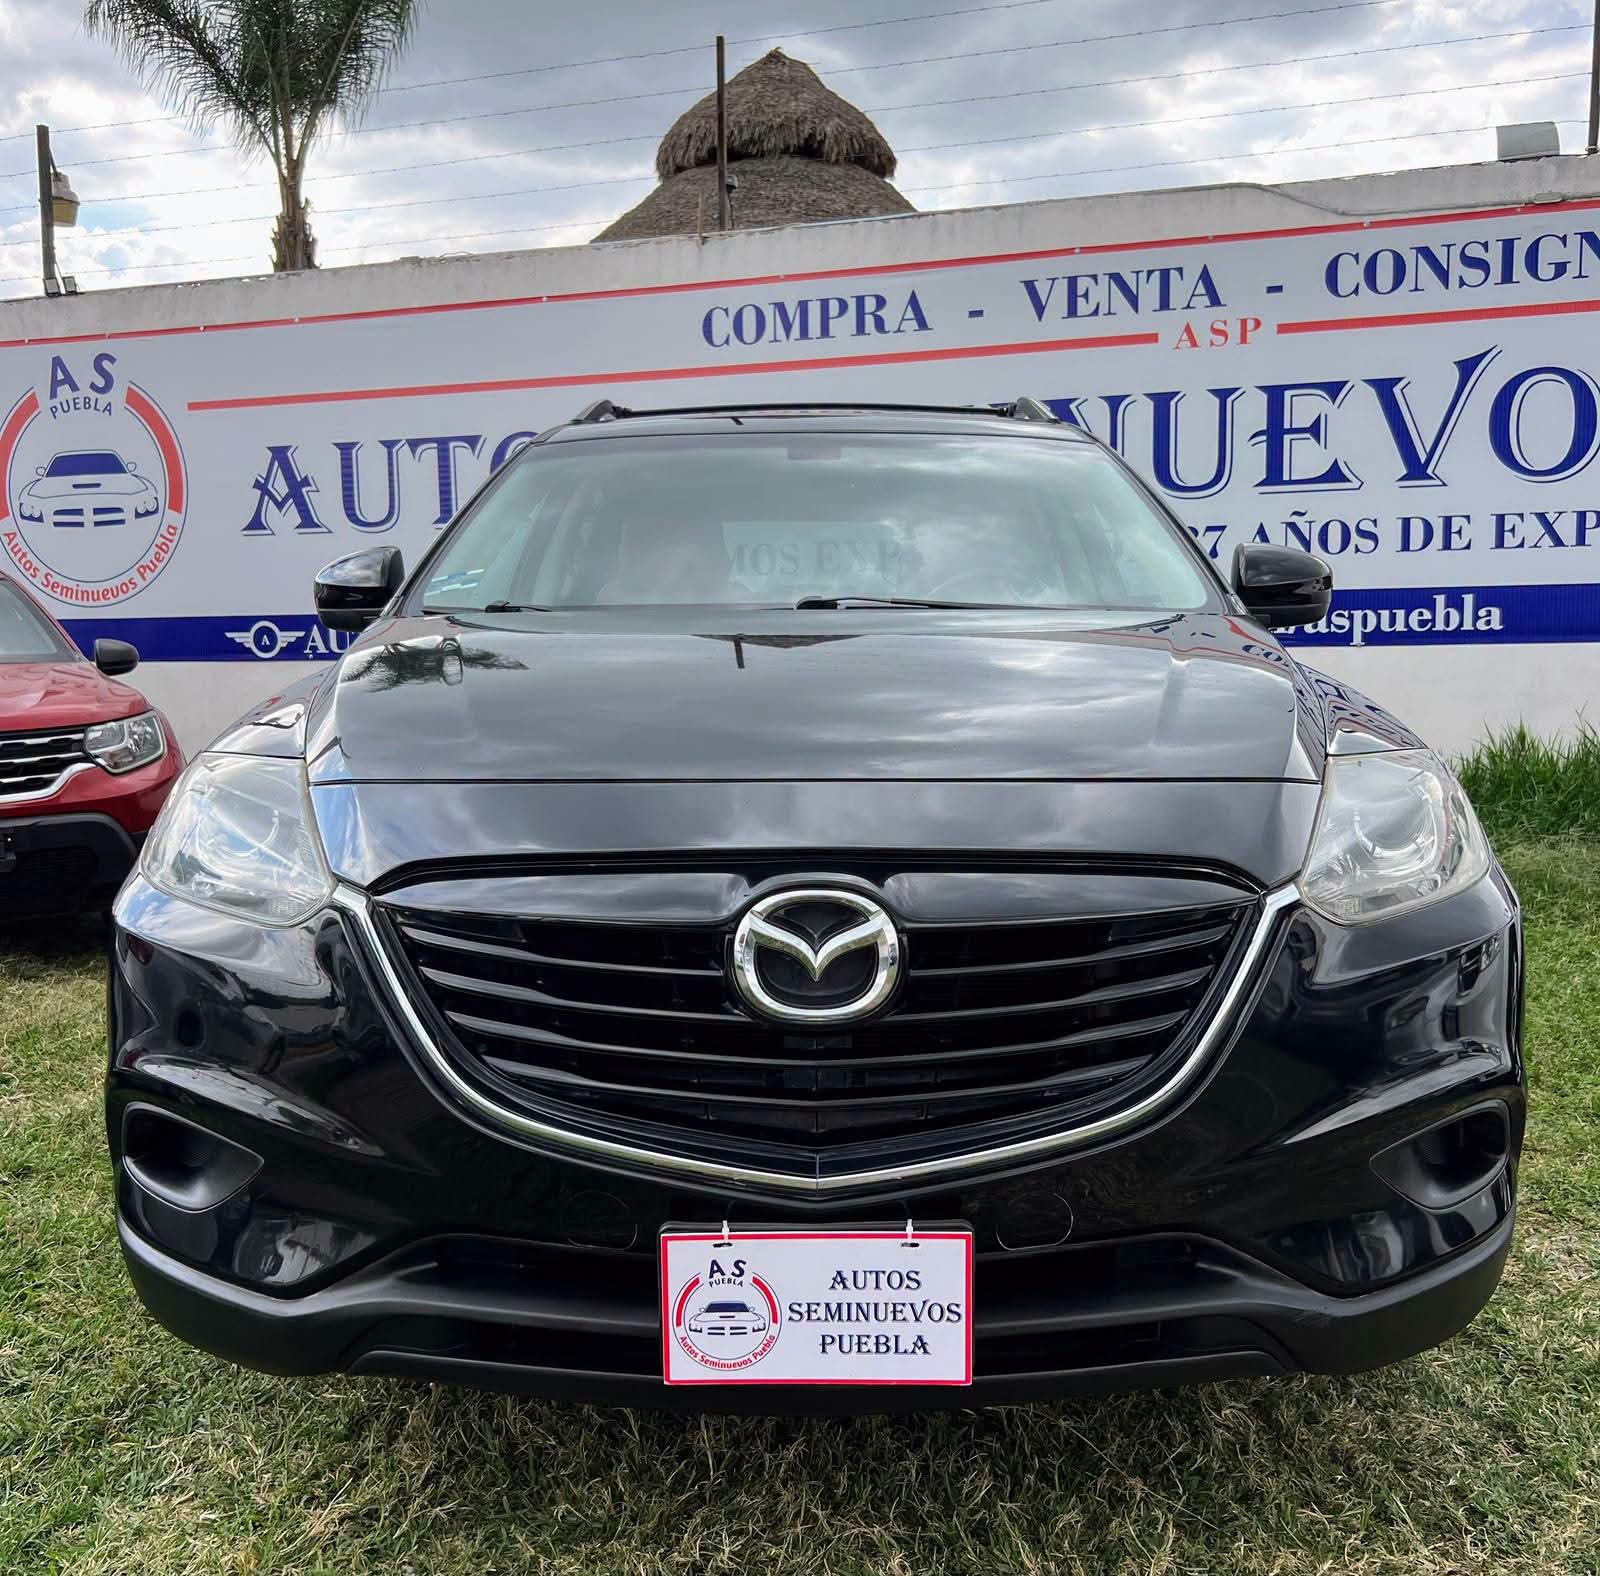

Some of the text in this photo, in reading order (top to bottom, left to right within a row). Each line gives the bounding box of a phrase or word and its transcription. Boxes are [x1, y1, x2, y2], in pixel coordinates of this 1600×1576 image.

[702, 289, 934, 347] COMPRA
[1019, 263, 1227, 322] VENTA
[1173, 317, 1262, 349] ASP
[50, 396, 113, 419] PUEBLA
[1187, 524, 1228, 559] 7
[1395, 514, 1472, 553] DE
[1489, 510, 1600, 549] EXP
[3, 524, 178, 602] Autos Seminuevos Puebla
[261, 635, 270, 645] A
[709, 1277, 744, 1288] PUEBLA
[829, 1270, 922, 1290] AUTOS
[788, 1299, 962, 1323] SEMINUEVOS
[680, 1335, 776, 1369] Autos Seminuevos Puebla
[819, 1334, 932, 1355] PUEBLA
